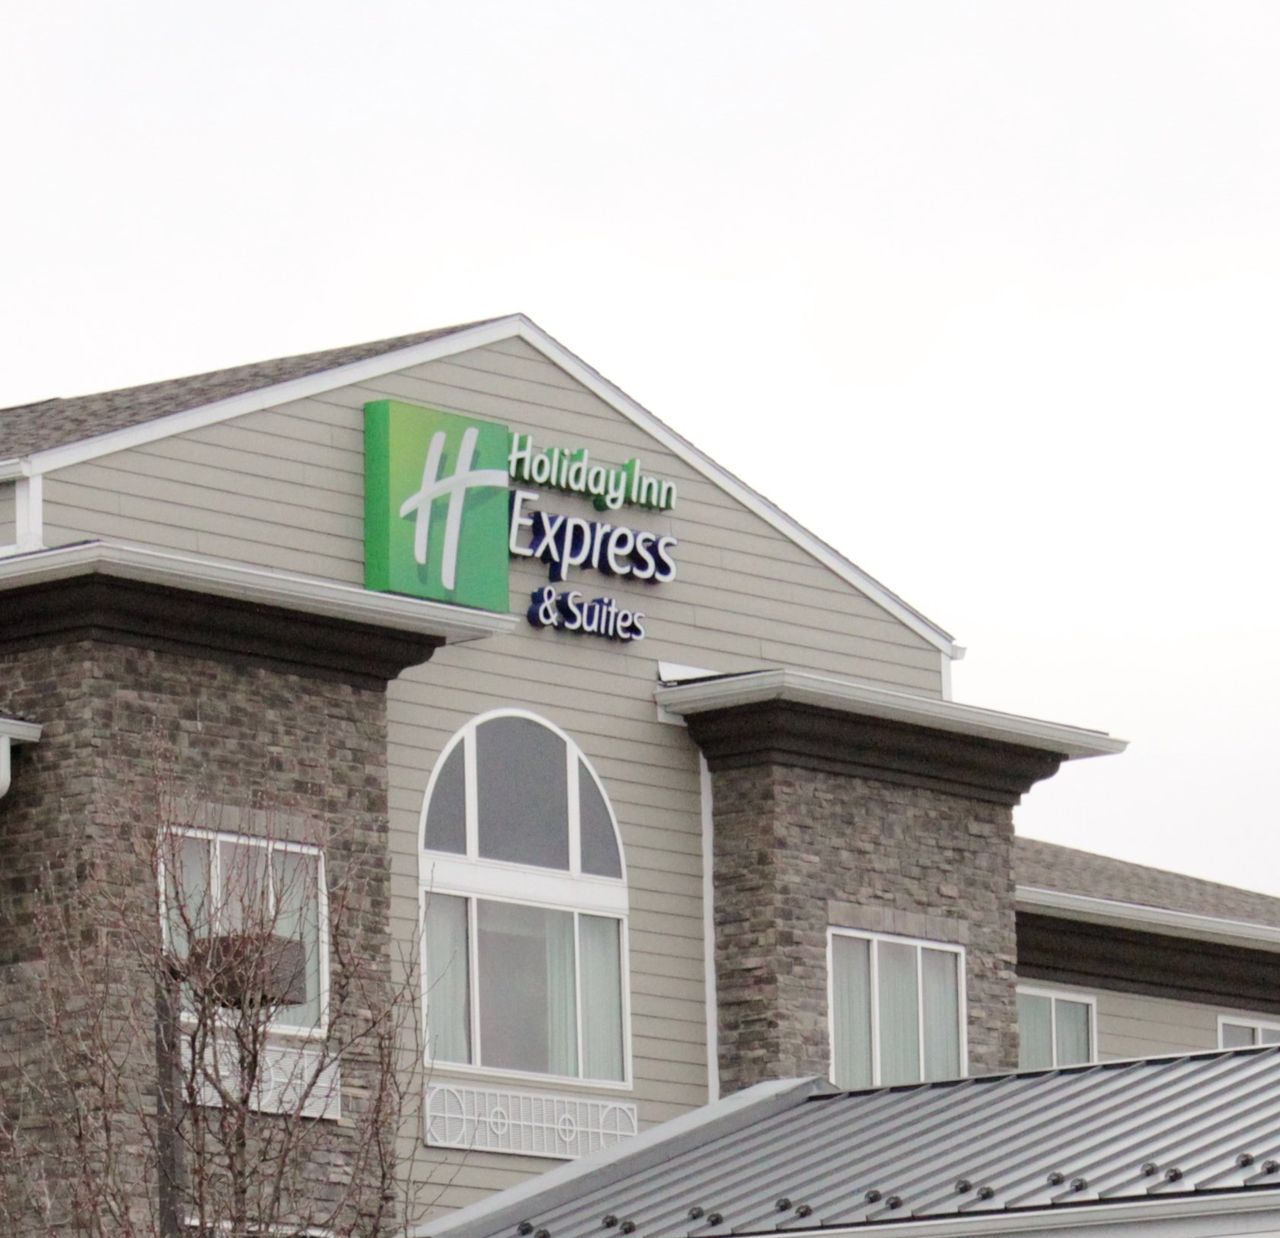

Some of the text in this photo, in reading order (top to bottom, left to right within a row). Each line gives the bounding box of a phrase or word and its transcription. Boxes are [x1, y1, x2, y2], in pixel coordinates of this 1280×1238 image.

[509, 432, 678, 511] Holiday Inn
[509, 490, 679, 583] Express
[537, 585, 647, 642] & Suites
